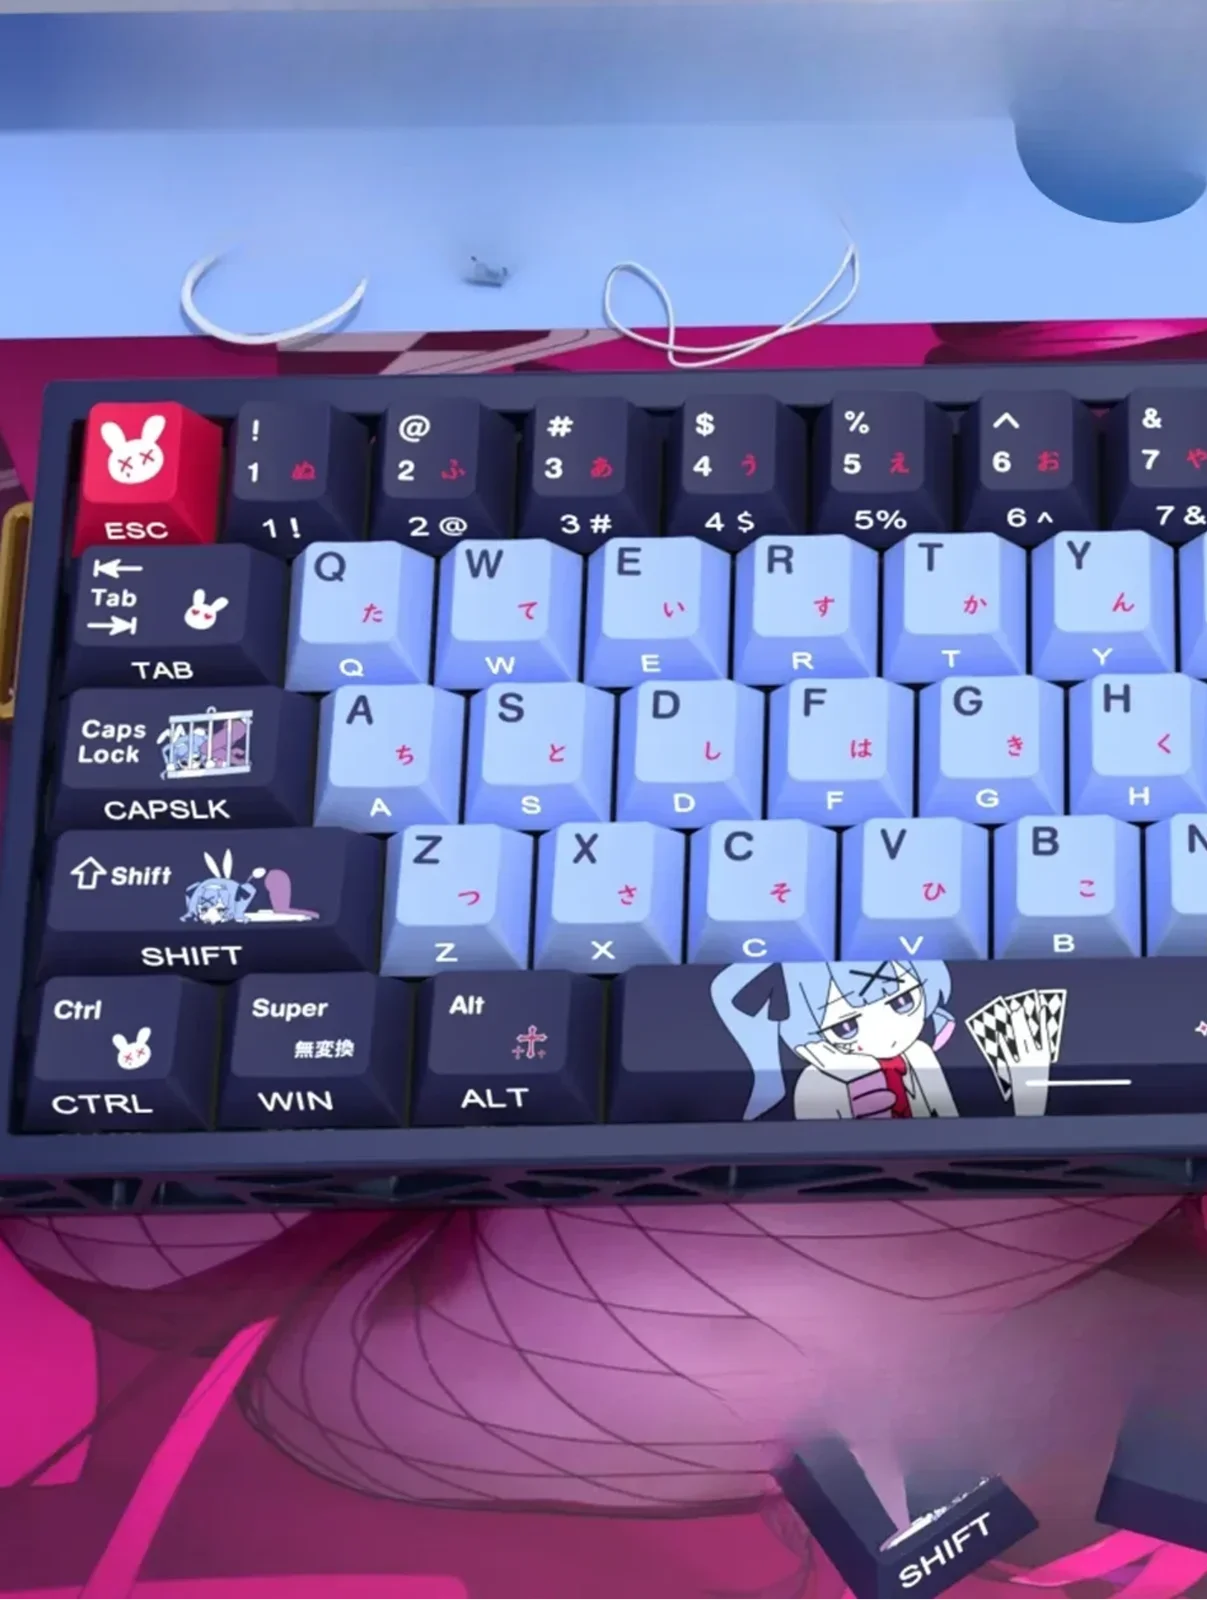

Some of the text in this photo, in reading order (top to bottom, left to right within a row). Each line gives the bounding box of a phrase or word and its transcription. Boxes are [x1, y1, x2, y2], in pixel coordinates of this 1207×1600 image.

[547, 416, 573, 436] #
[696, 412, 714, 436] $
[845, 411, 869, 433] %
[1143, 408, 1161, 428] &
[253, 420, 259, 441] !
[399, 415, 430, 442] @
[441, 459, 465, 480] ふ
[545, 458, 562, 478] 3
[591, 458, 612, 477] あ
[693, 456, 712, 476] 4
[742, 455, 757, 476] う
[844, 454, 861, 474] 5
[889, 453, 910, 475] え
[993, 451, 1011, 472] 6
[1038, 452, 1059, 471] お
[1142, 450, 1159, 469] 7
[248, 463, 258, 482] 1
[398, 460, 414, 480] 2
[105, 522, 168, 539] ESC
[409, 517, 467, 536] 2 @
[561, 514, 611, 533] 3 #
[705, 511, 754, 533] 4 $
[466, 549, 503, 578] W
[617, 547, 641, 576] E
[768, 545, 793, 574] R
[918, 543, 943, 571] T
[1067, 541, 1091, 569] Y
[314, 552, 346, 581] Q
[91, 589, 136, 607] Tab
[816, 596, 833, 616] す
[964, 596, 986, 614] か
[1112, 593, 1133, 612] ん
[362, 603, 384, 623] た
[520, 601, 538, 620] て
[663, 603, 686, 618] い
[485, 657, 515, 674] W
[641, 654, 660, 672] E
[792, 652, 813, 669] R
[942, 650, 960, 667] T
[1092, 648, 1112, 665] Y
[132, 662, 193, 679] TAB
[339, 659, 363, 676] Q
[499, 693, 524, 722] S
[653, 690, 680, 719] D
[804, 688, 826, 716] F
[954, 686, 982, 716] G
[1104, 684, 1130, 713] H
[346, 695, 373, 725] A
[82, 720, 145, 742] Caps
[704, 741, 720, 761] し
[850, 739, 871, 758] は
[1009, 736, 1023, 756] き
[1156, 733, 1171, 754] く
[79, 745, 138, 763] Lock
[397, 745, 414, 765] ち
[549, 745, 564, 763] と
[522, 796, 541, 814] S
[674, 793, 695, 812] D
[827, 791, 843, 809] F
[976, 789, 999, 807] G
[1129, 787, 1149, 805] H
[105, 800, 230, 820] CAPSLK
[371, 798, 391, 816] A
[413, 835, 442, 864] Z
[573, 834, 598, 863] X
[725, 831, 753, 861] C
[881, 829, 906, 860] V
[1033, 827, 1059, 856] B
[111, 867, 171, 885] Shift
[459, 890, 481, 905] つ
[619, 885, 636, 906] さ
[770, 882, 792, 903] そ
[923, 881, 945, 902] ひ
[1080, 878, 1095, 899] こ
[435, 943, 457, 962] Z
[592, 941, 615, 959] X
[743, 938, 767, 957] C
[900, 936, 923, 954] V
[1054, 934, 1074, 952] B
[142, 946, 242, 966] SHIFT
[54, 1000, 101, 1019] Ctrl
[253, 998, 328, 1021] Super
[449, 995, 484, 1014] Alt
[295, 1039, 354, 1058] 無変換
[52, 1094, 153, 1114] CTRL
[258, 1091, 333, 1111] WIN
[462, 1088, 528, 1108] ALT
[899, 1511, 991, 1588] SHIFT
